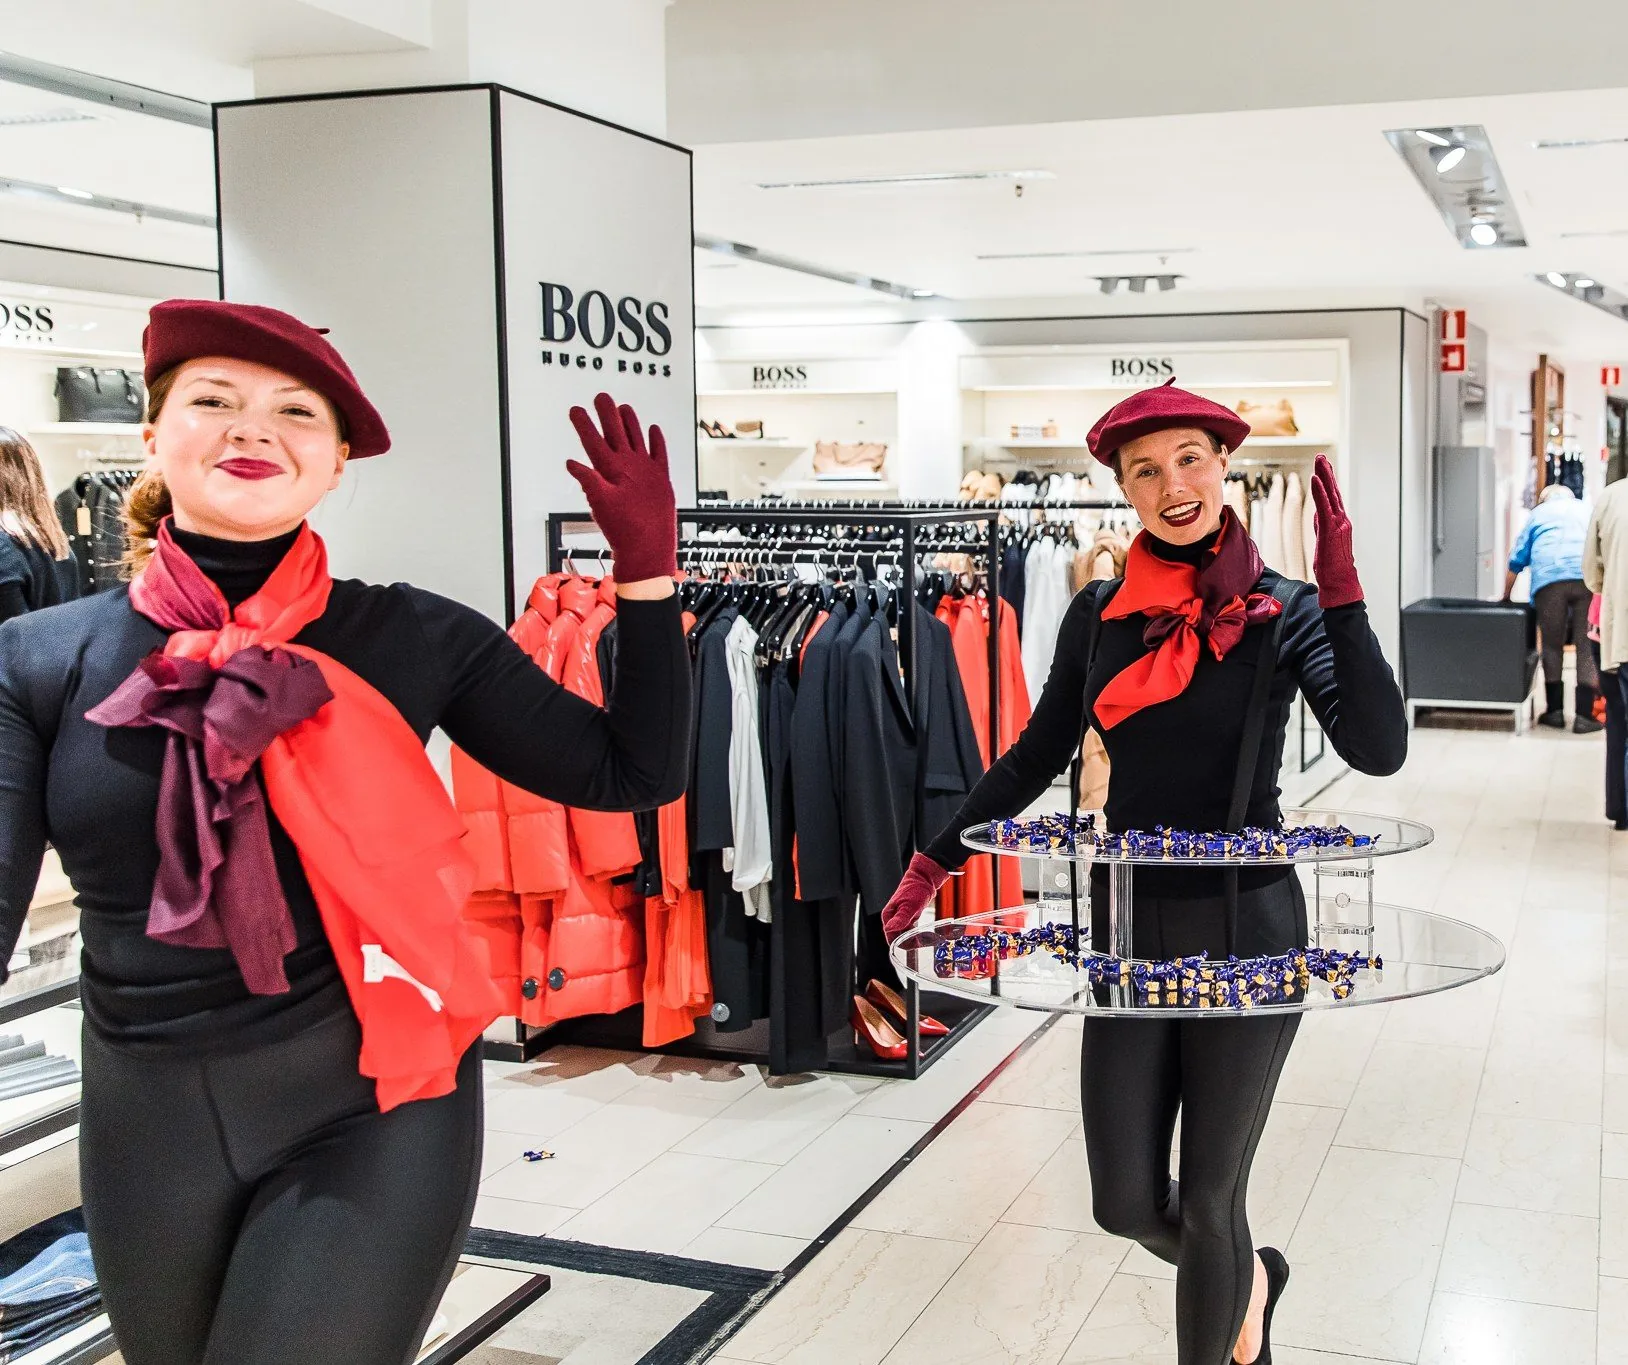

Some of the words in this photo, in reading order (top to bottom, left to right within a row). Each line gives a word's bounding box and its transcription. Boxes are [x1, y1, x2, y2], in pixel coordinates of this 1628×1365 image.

[538, 281, 672, 356] BOSS
[542, 350, 603, 370] HUGO
[618, 359, 671, 377] BOSS
[753, 365, 807, 382] BOSS
[1111, 358, 1173, 376] BOSS
